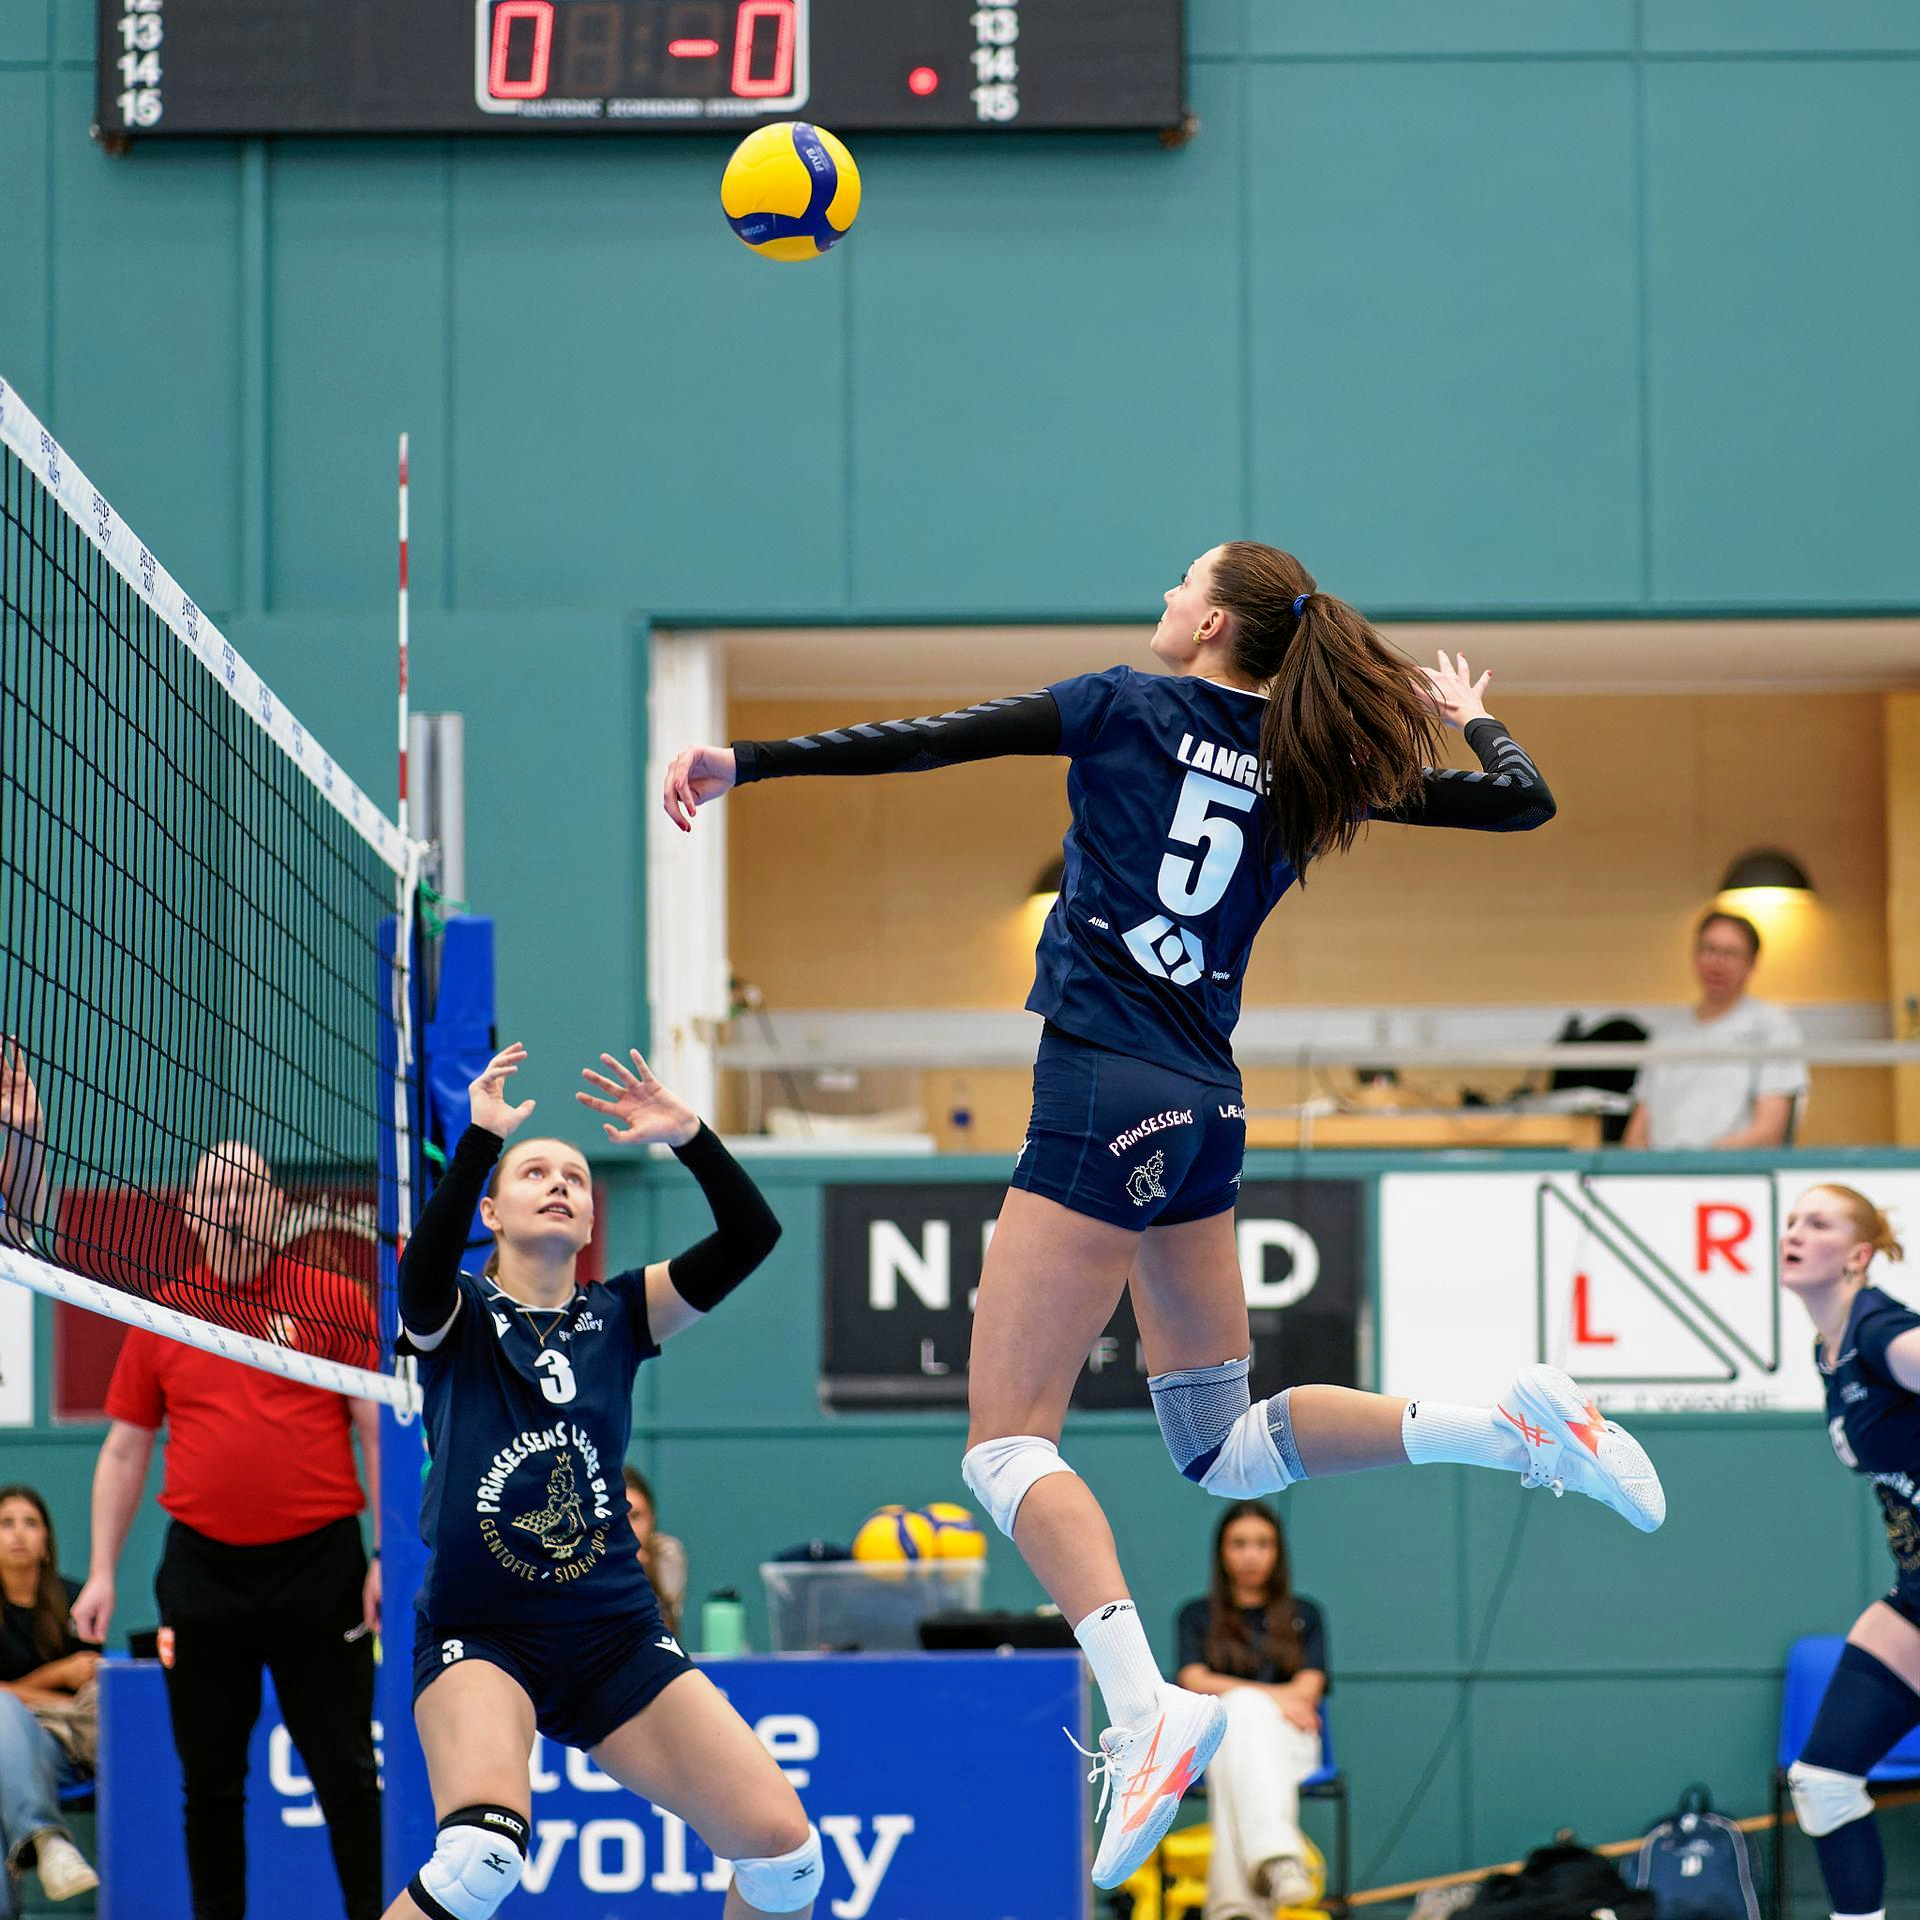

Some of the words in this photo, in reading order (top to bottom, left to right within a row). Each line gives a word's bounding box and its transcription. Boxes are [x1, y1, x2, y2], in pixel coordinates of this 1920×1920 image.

[117, 13, 163, 50] 13
[969, 8, 1019, 45] 13
[489, 1, 554, 98] 0
[731, 0, 795, 98] 0
[969, 46, 1018, 82] 14
[117, 51, 163, 88] 14
[116, 88, 163, 127] 15
[969, 83, 1019, 121] 15
[1157, 770, 1257, 917] 5
[1088, 916, 1109, 930] Atlas
[1696, 1204, 1752, 1273] R
[1574, 1273, 1617, 1344] L
[533, 1349, 577, 1404] 3
[590, 1477, 613, 1519] BAG
[479, 1518, 538, 1581] GENTOFTE
[554, 1551, 597, 1584] SIDEN
[442, 1639, 464, 1665] 3
[484, 1812, 524, 1834] SELECT
